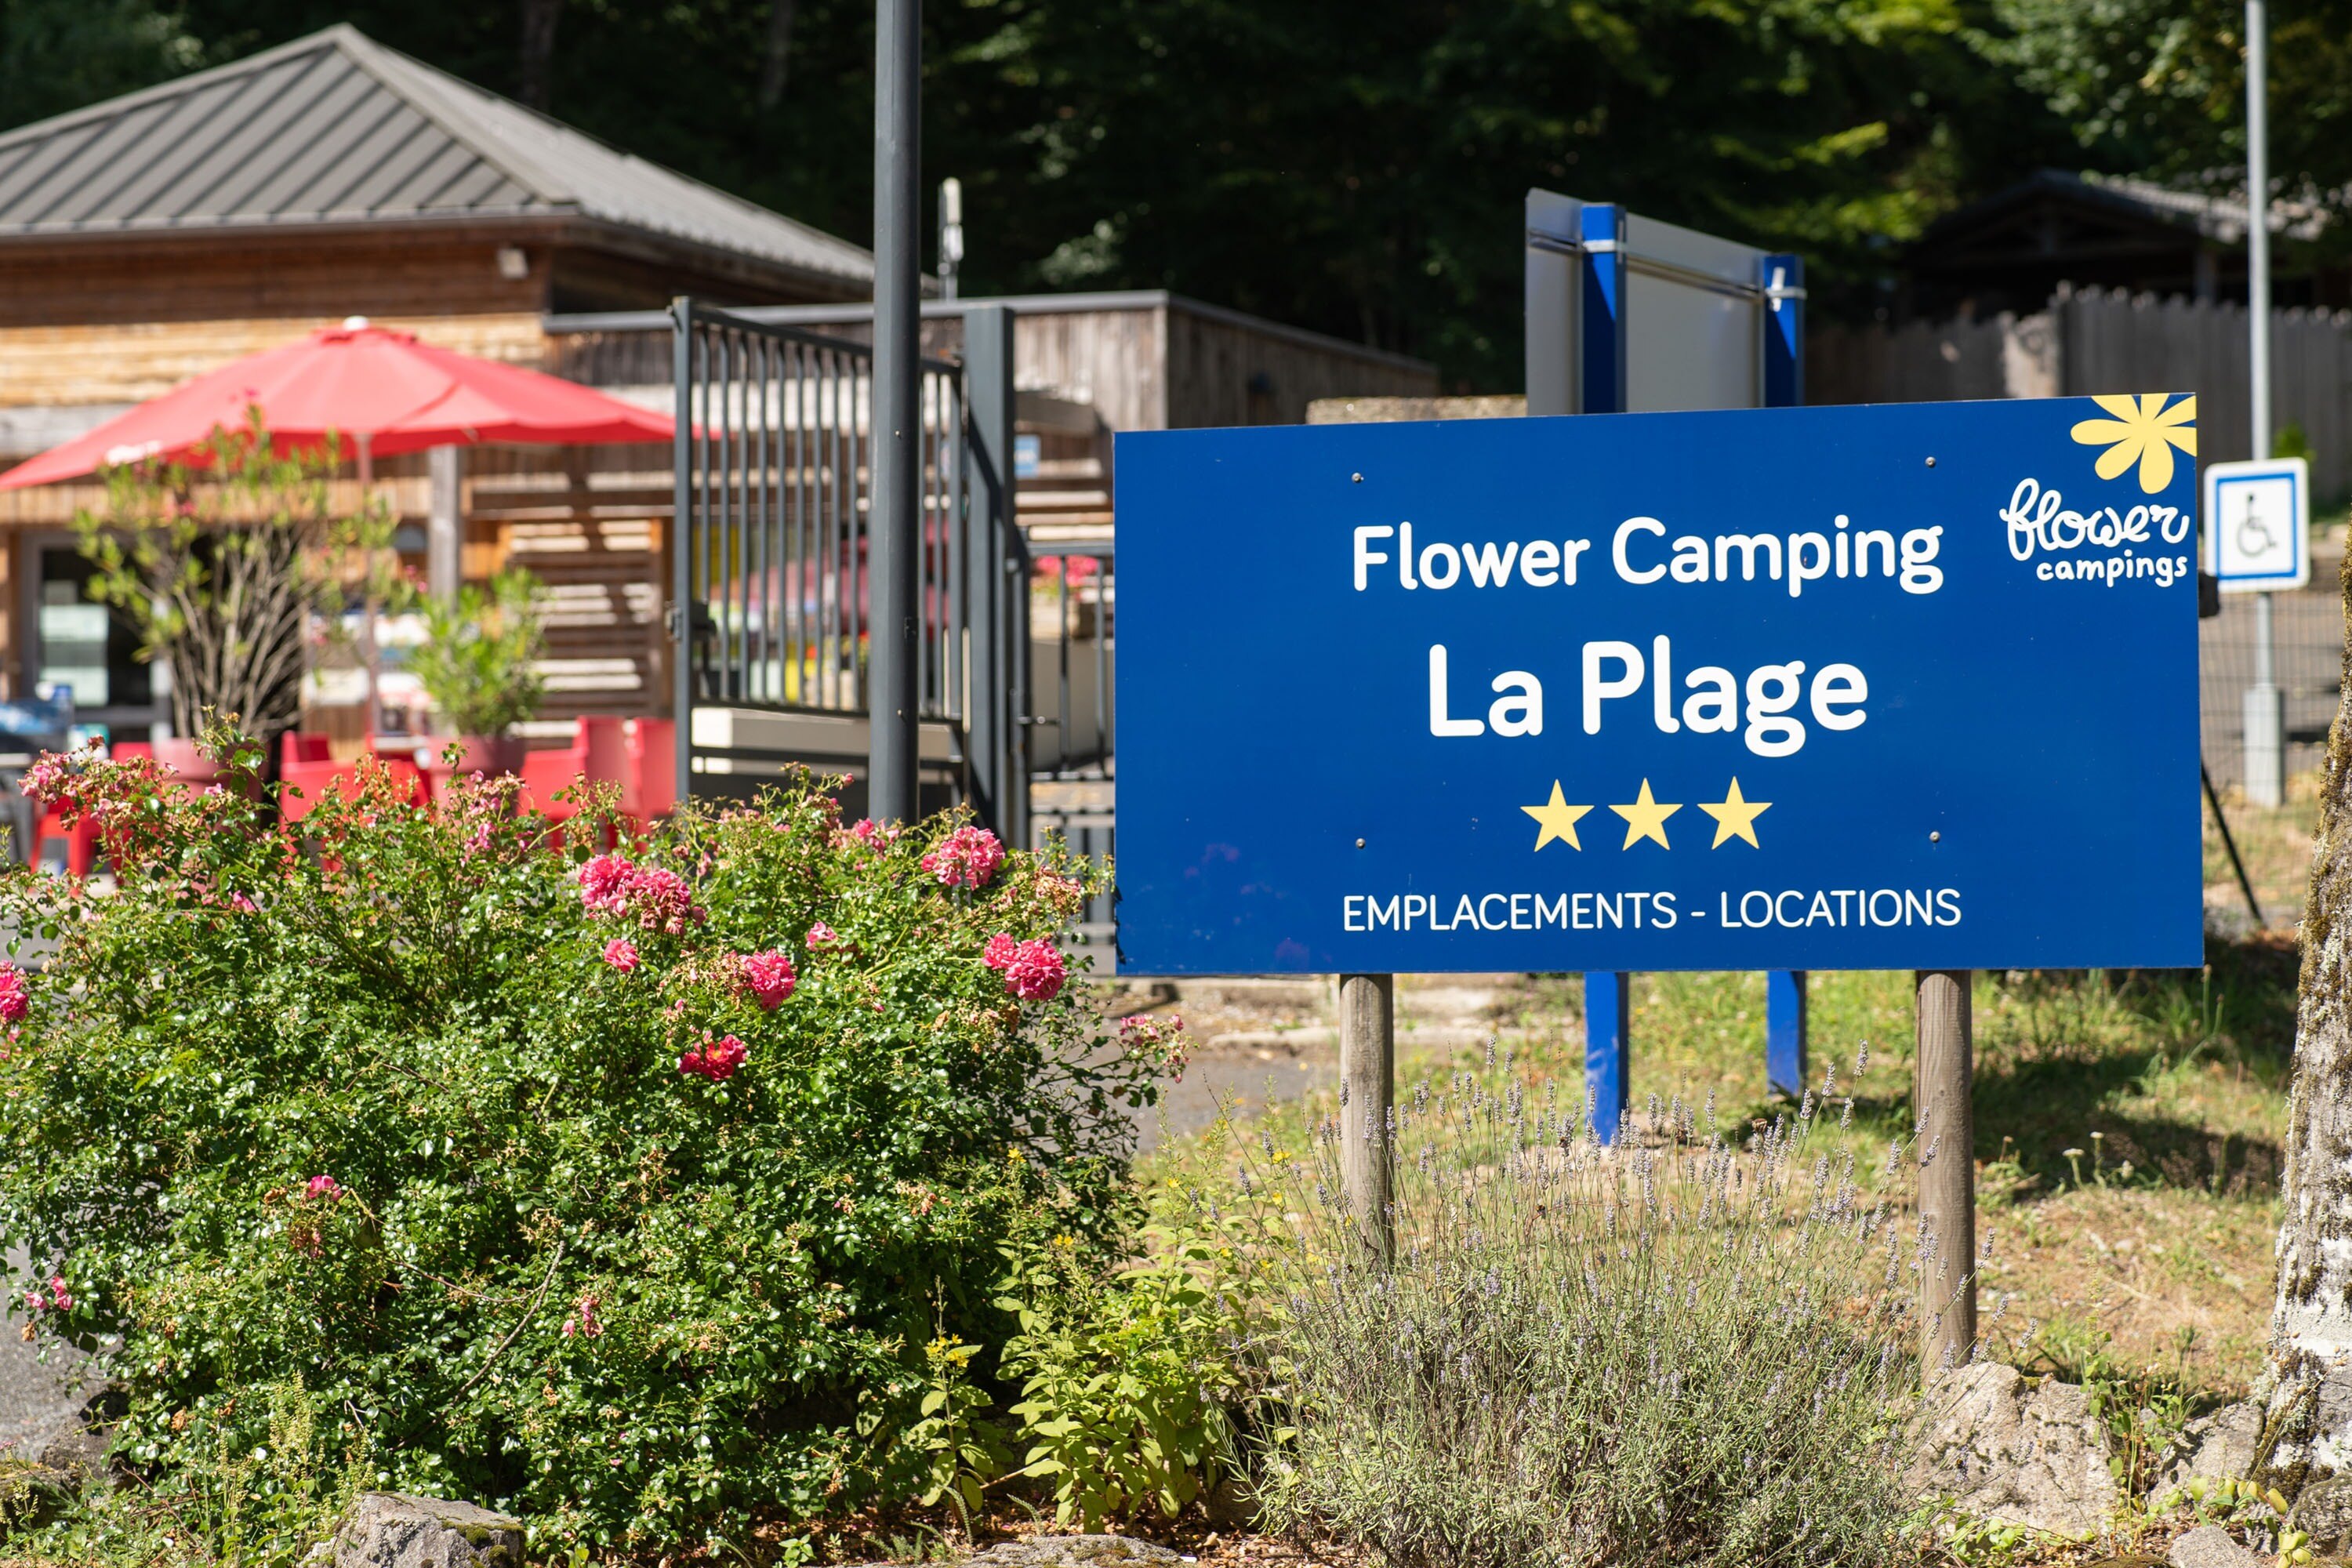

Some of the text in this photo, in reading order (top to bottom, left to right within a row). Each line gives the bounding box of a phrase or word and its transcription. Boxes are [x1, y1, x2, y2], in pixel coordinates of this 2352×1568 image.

[1354, 514, 1944, 597] Flower Camping
[1999, 477, 2190, 561] flower
[2036, 549, 2187, 588] campings
[1429, 634, 1868, 757] La Plage
[1344, 891, 1677, 931] EMPLACEMENTS
[1721, 888, 1962, 928] LOCATIONS
